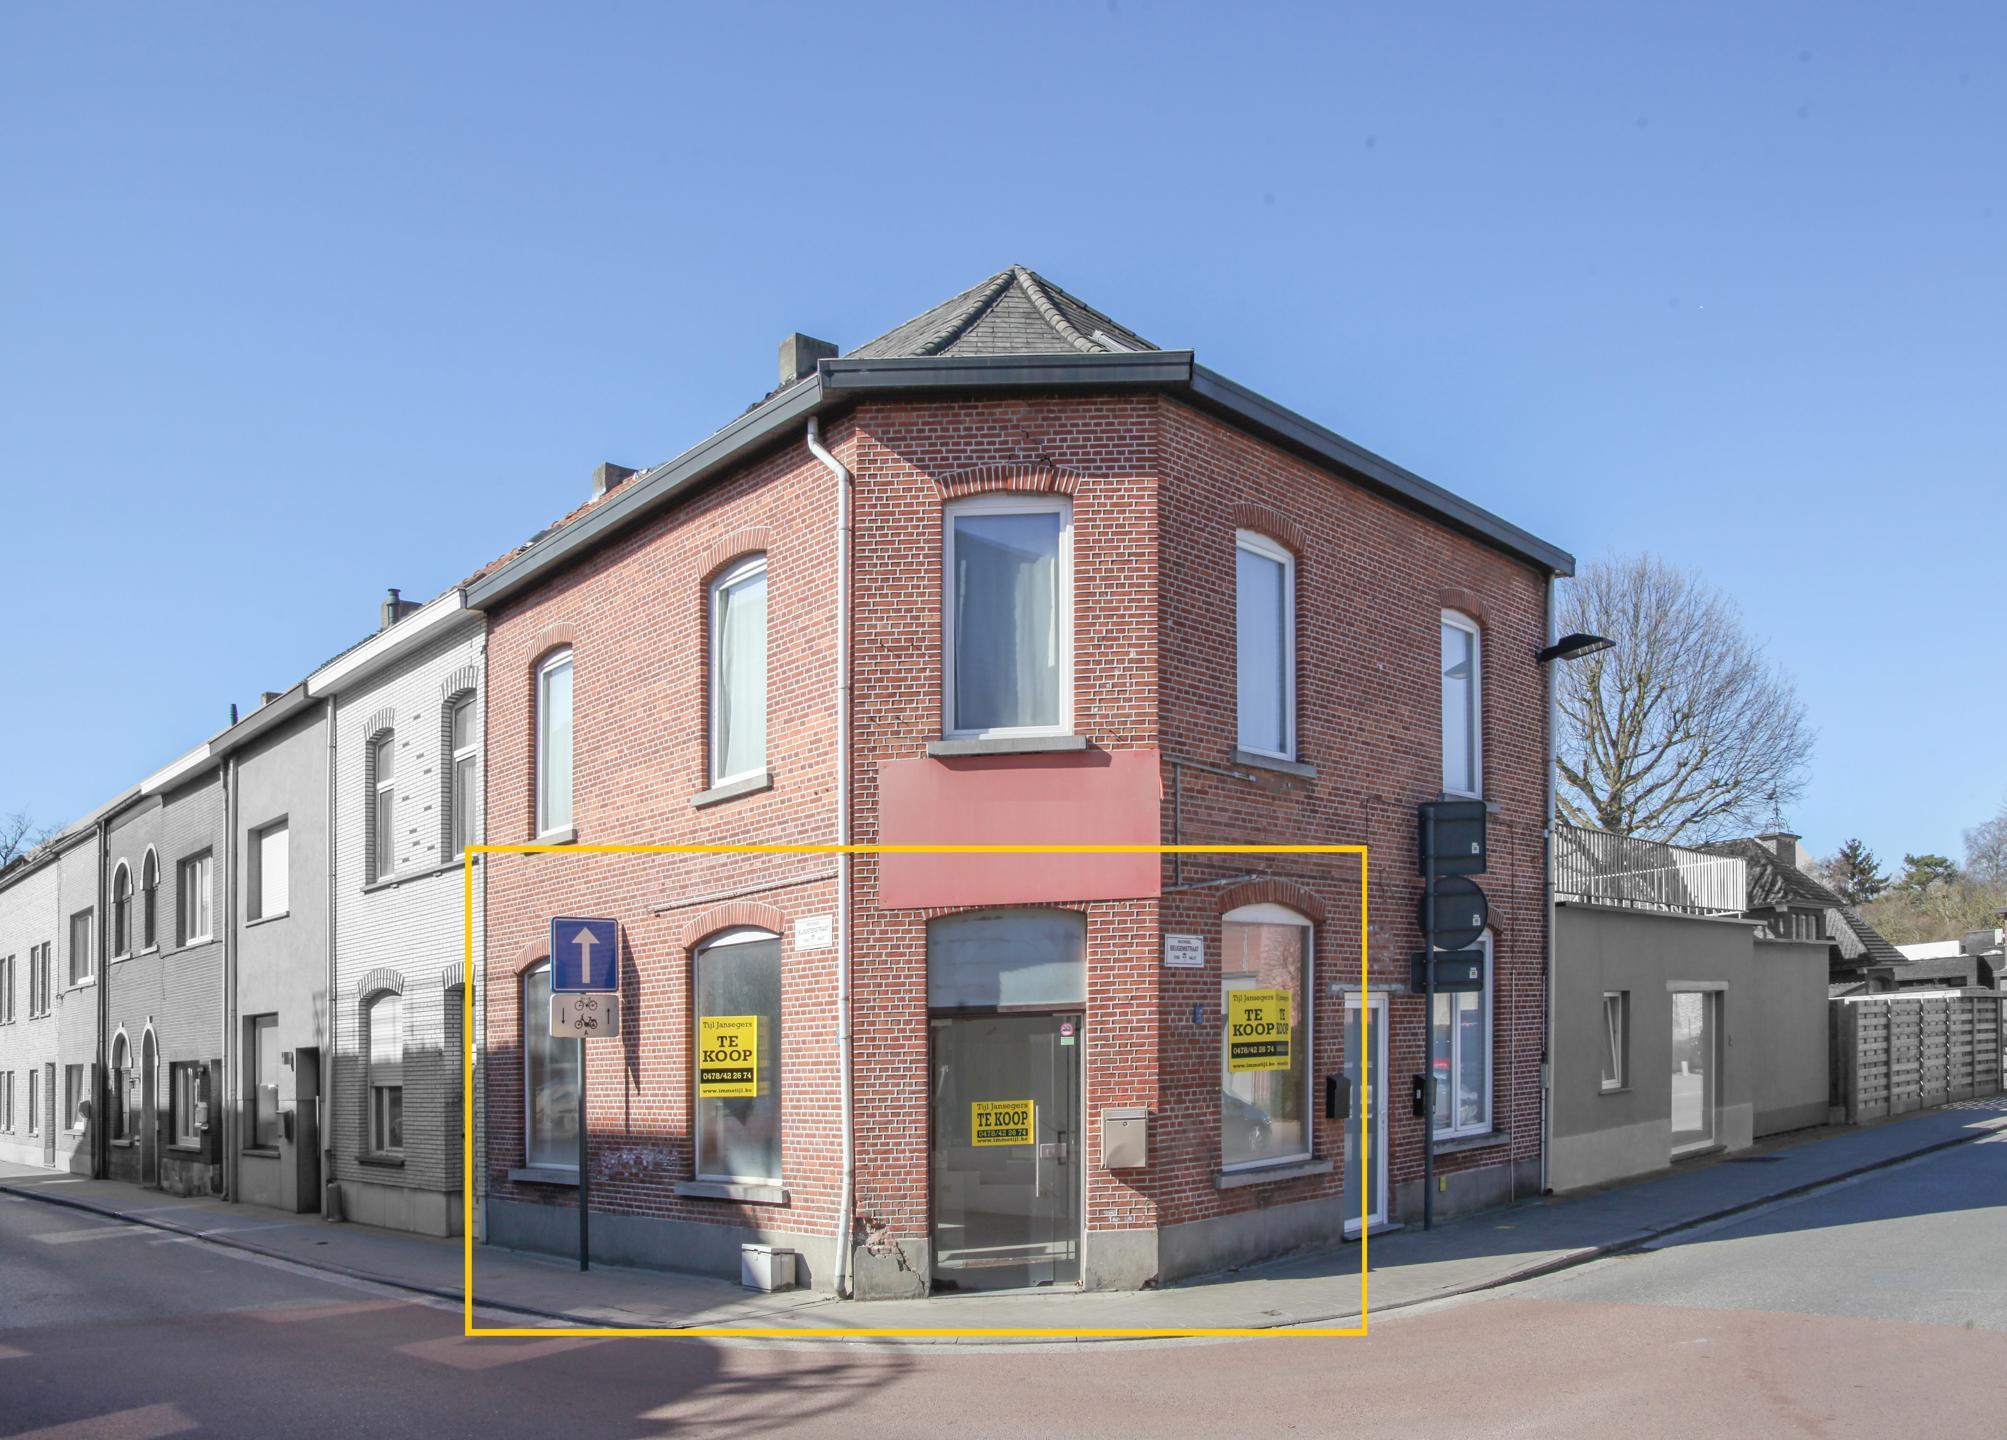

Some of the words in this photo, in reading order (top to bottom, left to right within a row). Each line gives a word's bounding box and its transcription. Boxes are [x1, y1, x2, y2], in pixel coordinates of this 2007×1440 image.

[1233, 994, 1243, 1003] Tijl
[1244, 994, 1274, 1003] Jansegers
[1244, 1008, 1263, 1021] TE
[703, 1022, 714, 1030] Tijl
[716, 1021, 752, 1030] Jansegers
[1232, 1023, 1275, 1037] KOOP
[717, 1035, 738, 1048] TE
[702, 1049, 752, 1062] KOOP
[703, 1072, 732, 1080] 0478/42
[743, 1071, 752, 1079] 74
[977, 1103, 989, 1111] Tijl
[991, 1103, 1028, 1111] Jansegers
[977, 1113, 991, 1127] TE
[994, 1111, 1028, 1126] KOOP
